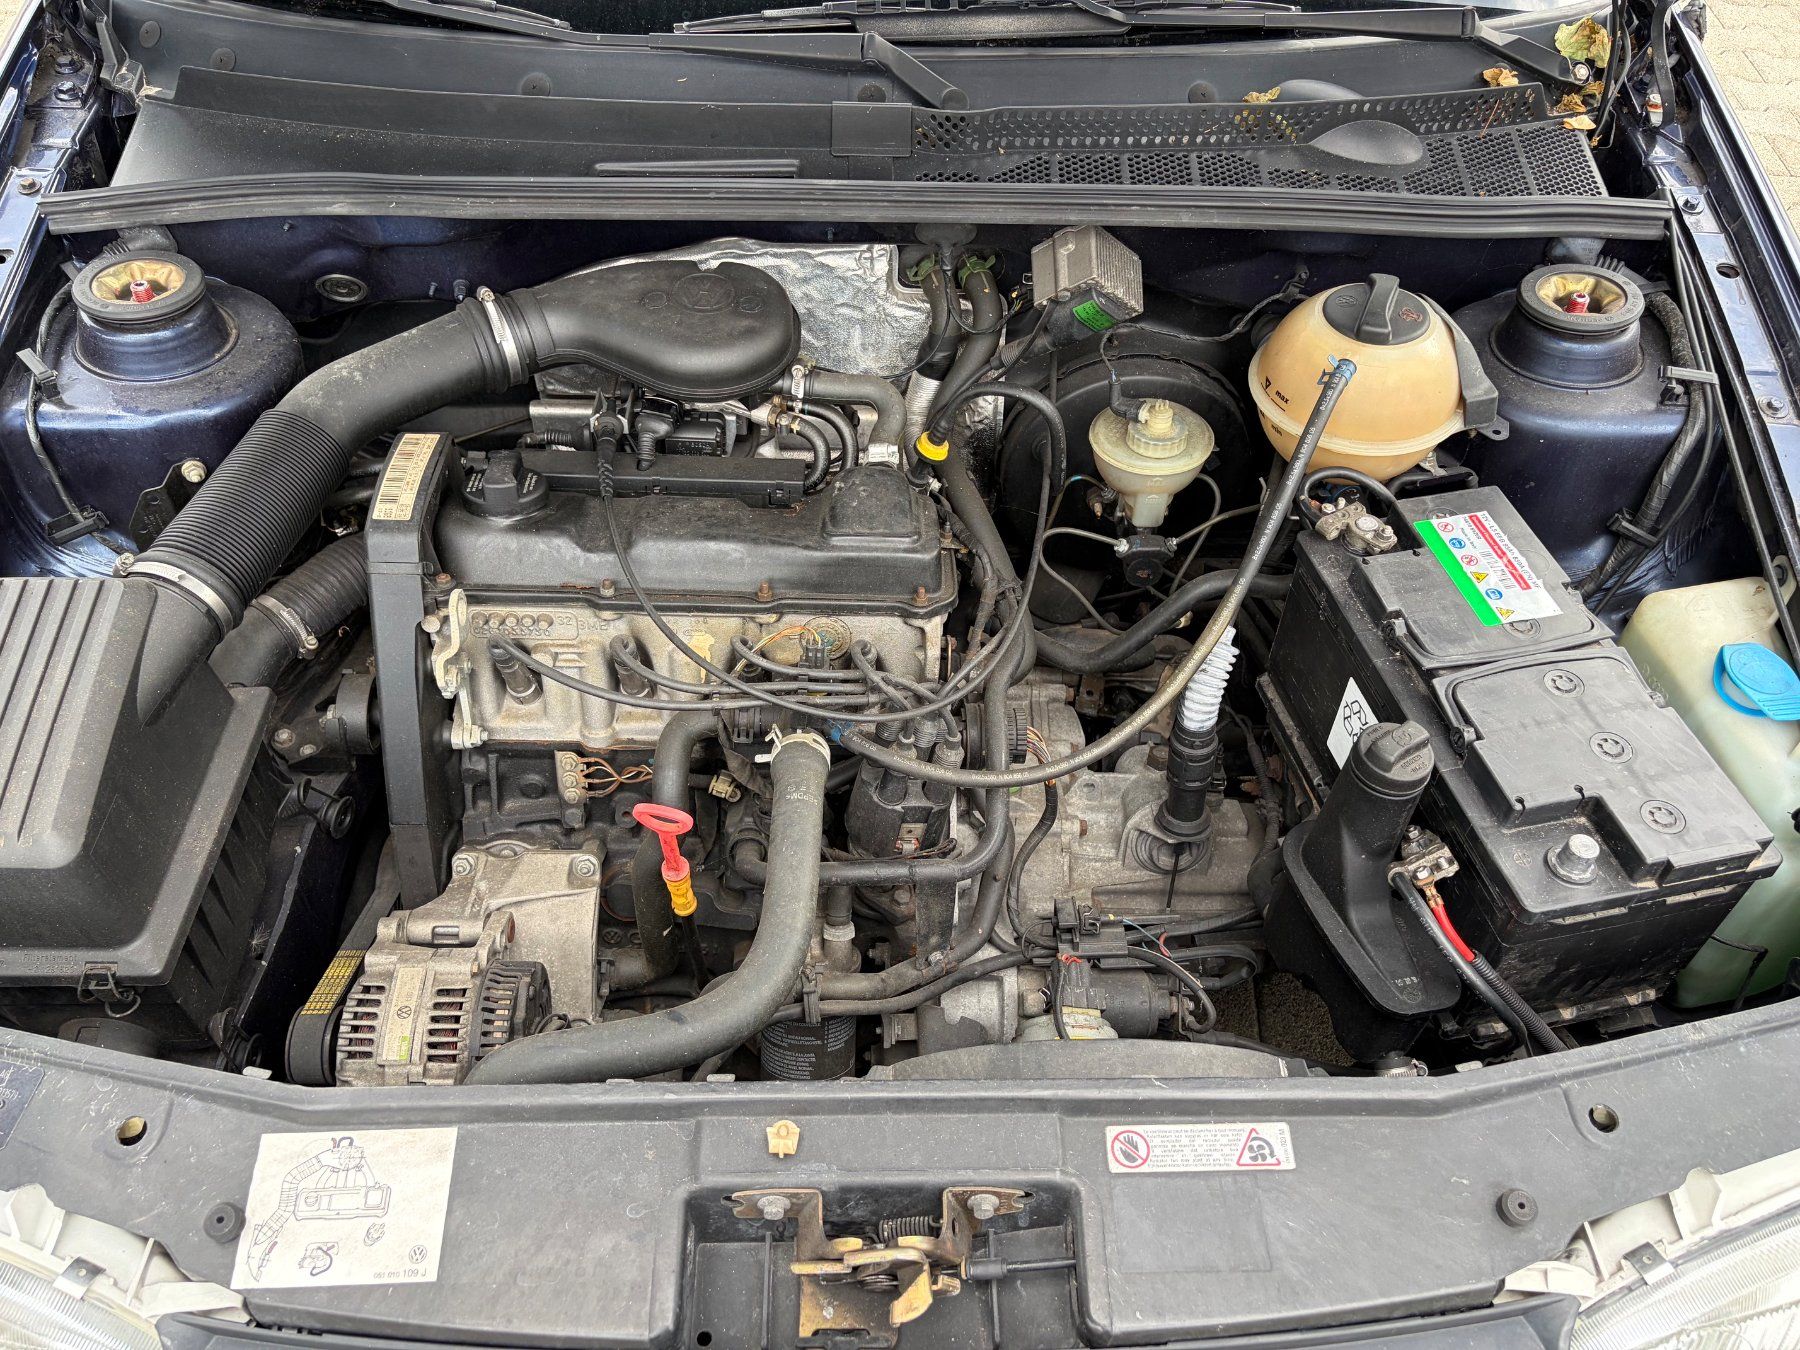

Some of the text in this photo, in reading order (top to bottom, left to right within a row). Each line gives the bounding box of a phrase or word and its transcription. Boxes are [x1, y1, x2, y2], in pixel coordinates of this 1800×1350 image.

[1274, 390, 1290, 404] max
[403, 1268, 419, 1278] 109
[421, 1268, 427, 1277] J
